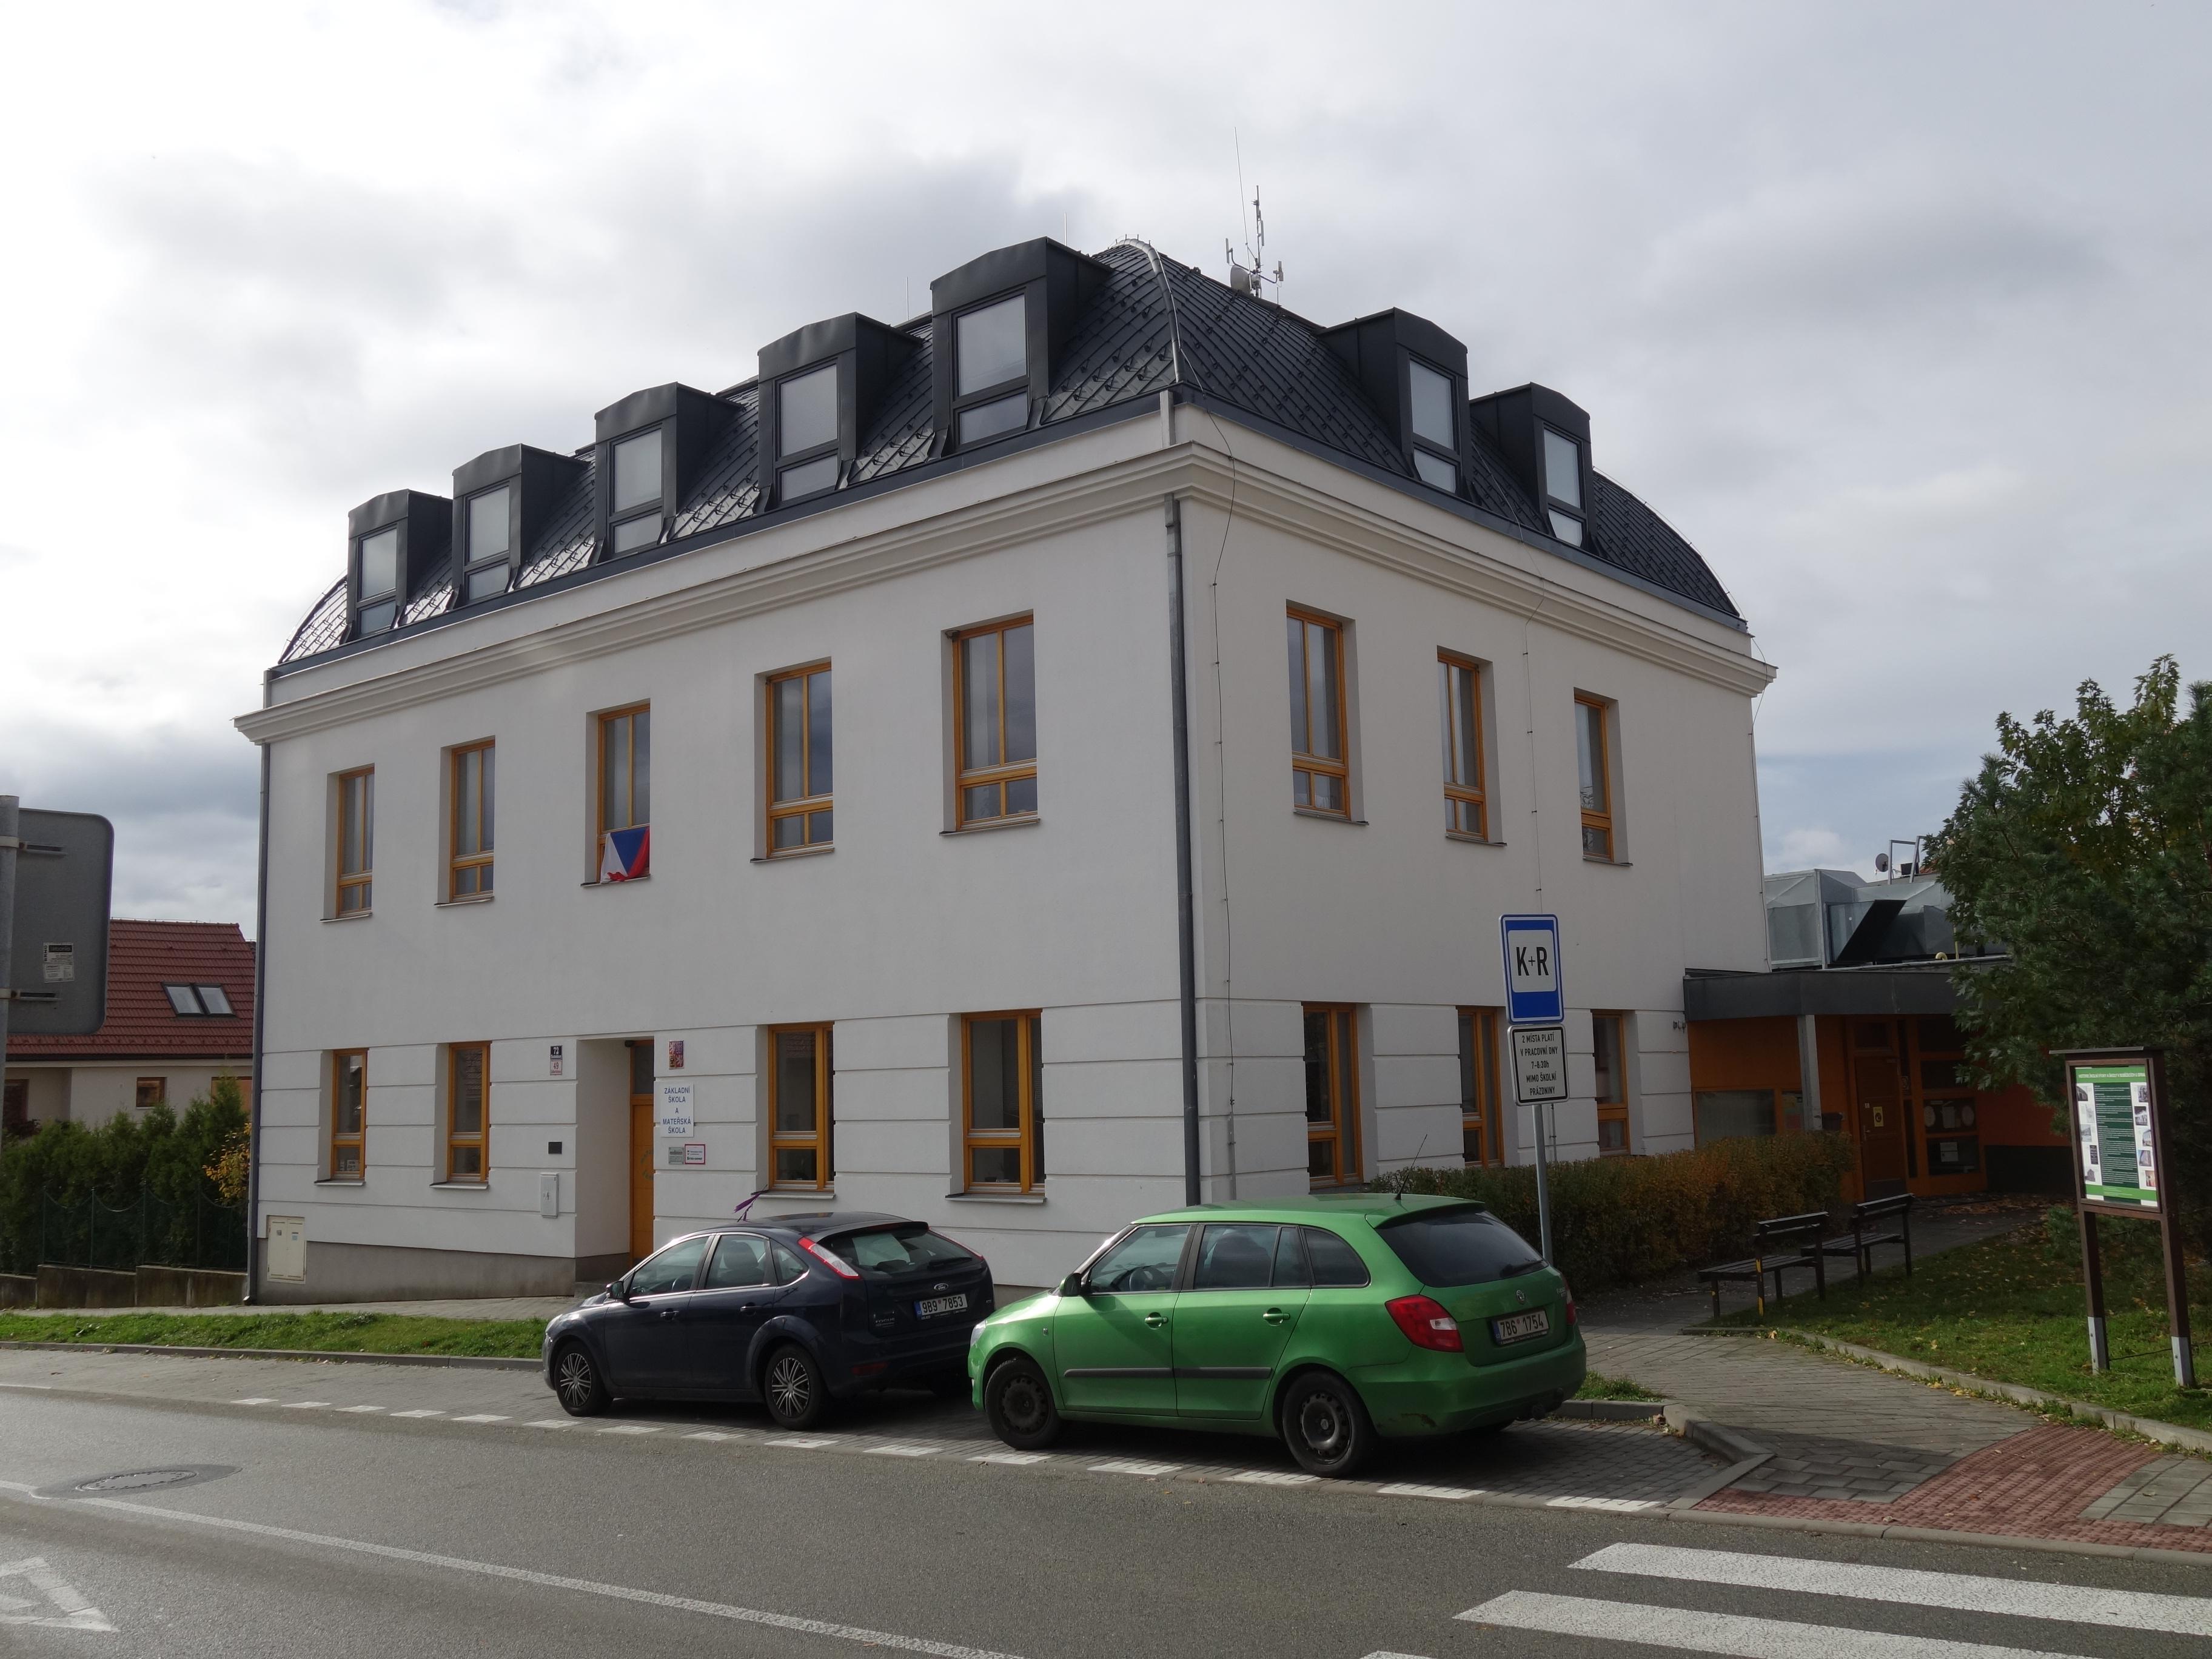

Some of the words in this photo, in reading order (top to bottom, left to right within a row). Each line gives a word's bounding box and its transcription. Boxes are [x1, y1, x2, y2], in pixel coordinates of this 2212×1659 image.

[1516, 947, 1549, 976] K+R
[1526, 1033, 1541, 1043] MÍSTA
[1541, 1032, 1555, 1042] PLATÍ
[1524, 1046, 1549, 1056] PRACOVNÍ
[1549, 1046, 1558, 1055] DNY
[1526, 1074, 1540, 1083] MIMO
[1540, 1071, 1557, 1082] ŠKOLNÍ
[1530, 1085, 1555, 1096] PRÁZDNINY
[662, 1116, 691, 1125] MATEŘSKÁ
[922, 1300, 938, 1313] 9B9
[942, 1296, 964, 1310] 7853
[1501, 1320, 1517, 1337] 7B6
[1523, 1314, 1544, 1332] 1754
